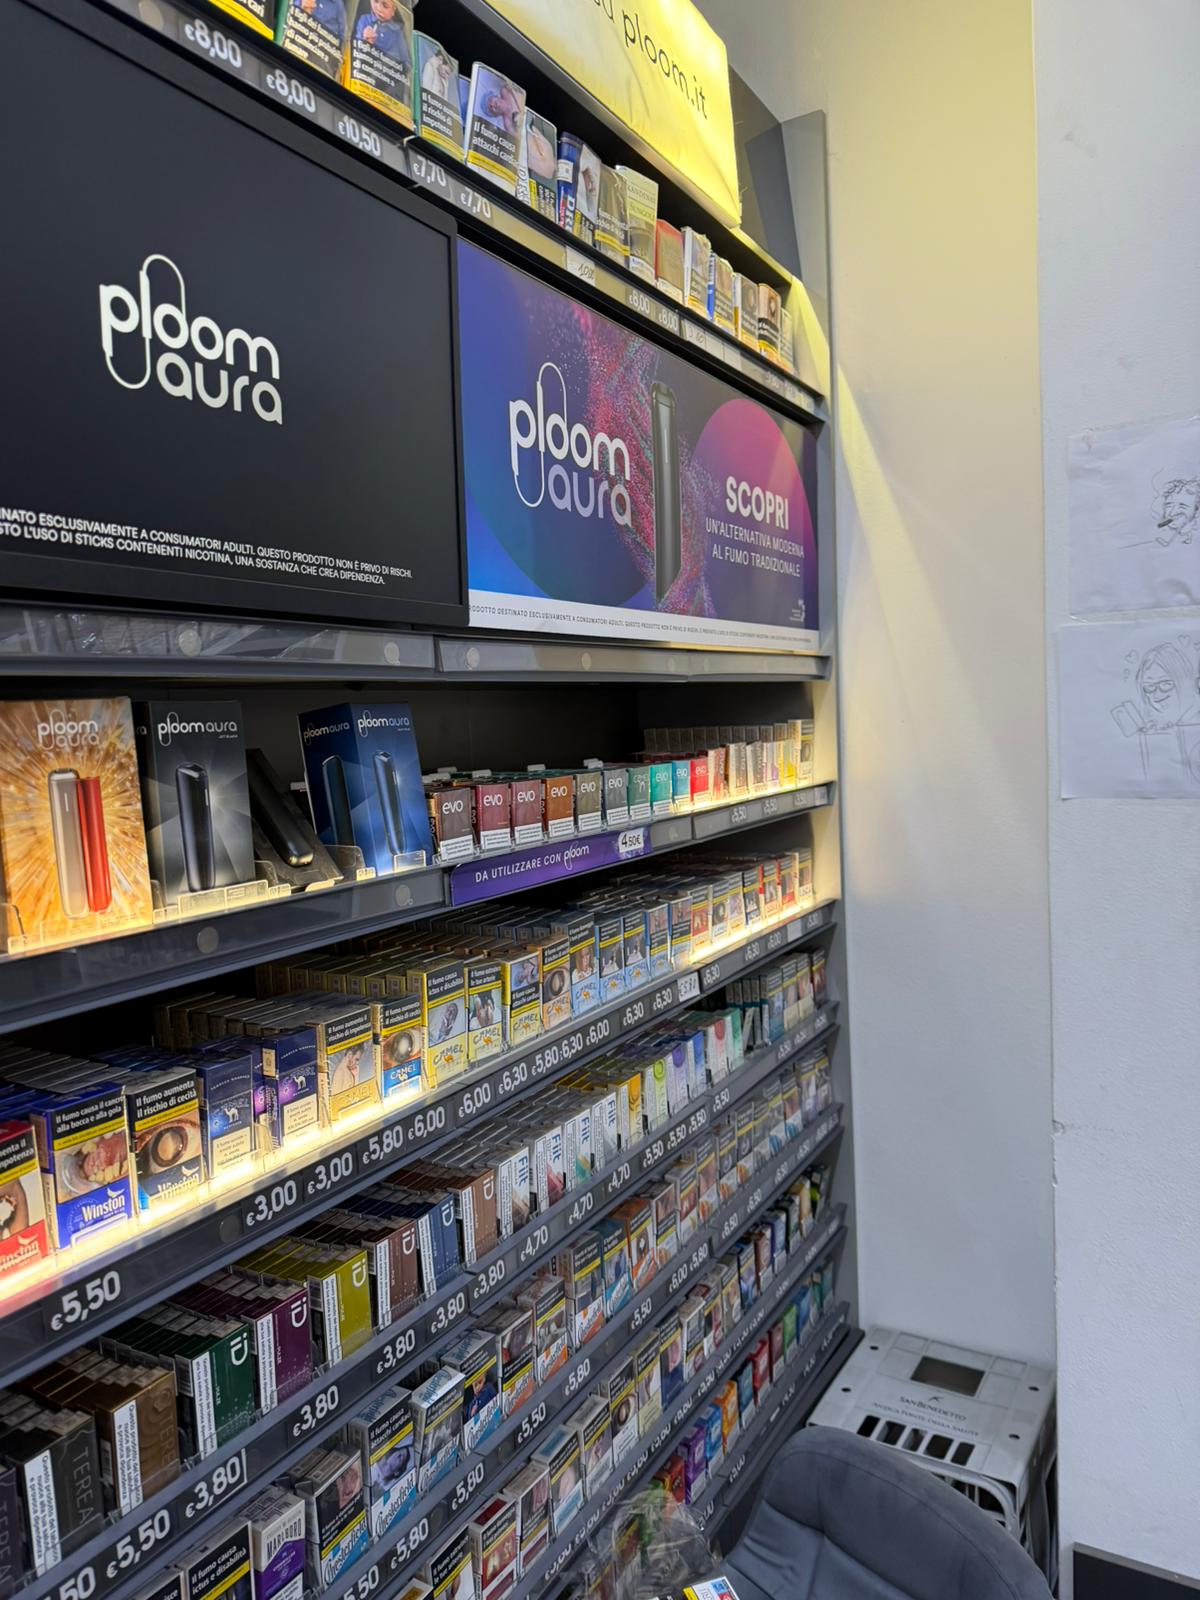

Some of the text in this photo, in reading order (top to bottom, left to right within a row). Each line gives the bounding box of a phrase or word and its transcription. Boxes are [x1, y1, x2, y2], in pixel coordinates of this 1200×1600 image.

[184, 19, 243, 69] €8,00
[622, 10, 707, 120] ploom.it
[266, 69, 316, 113] €8,00
[338, 115, 382, 157] €10,50
[413, 154, 447, 187] €7,70
[460, 186, 491, 218] €7,70
[99, 254, 281, 389] ploom
[157, 352, 283, 425] aura
[509, 362, 631, 507] ploom
[548, 464, 632, 527] aura
[725, 476, 790, 530] SCOPRI
[39, 513, 138, 539] ESCLUSIVAMENTE
[140, 528, 149, 540] A
[150, 530, 221, 551] CONSUMATORI
[223, 541, 255, 555] ADULTI.
[257, 546, 291, 561] QUESTO
[292, 552, 335, 567] PRODOTTO
[336, 559, 353, 570] NON
[354, 560, 359, 571] È
[360, 562, 381, 574] PRIVO
[382, 566, 390, 575] DI
[390, 567, 412, 579] RISCHI.
[706, 517, 805, 559] UN'ALTERNATIVA MODERNA
[24, 526, 58, 543] L'USO
[61, 531, 73, 544] DI
[75, 533, 114, 549] STICKS
[116, 539, 183, 558] CONTENENTI
[185, 549, 234, 565] NICOTINA,
[235, 556, 254, 567] UNA
[255, 558, 300, 574] SOSTANZA
[301, 565, 317, 576] CHE
[318, 567, 339, 579] CREA
[340, 571, 386, 585] DIPENDENZA.
[712, 544, 801, 577] AL FUMO TRADIZIONALE
[37, 709, 98, 750] ploom
[56, 733, 100, 747] aura
[157, 712, 238, 746] ploom aura
[358, 710, 410, 737] ploom aura
[580, 781, 596, 793] evo
[608, 777, 623, 789] evo
[676, 767, 688, 777] evo
[442, 800, 464, 815] evo
[483, 794, 503, 807] evo
[517, 790, 536, 803] evo
[551, 785, 568, 798] evo
[476, 841, 590, 883] DA UTILIZZARE CON ploom
[623, 1002, 644, 1027] €6,30
[653, 988, 673, 1011] €6,30
[473, 1028, 501, 1045] CAMEL
[513, 1013, 538, 1031] CAMEL
[586, 1019, 610, 1046] €6,00
[390, 1063, 417, 1081] CAMEL
[433, 1044, 464, 1066] CAMEL
[531, 1046, 559, 1076] €5,80
[136, 1080, 195, 1107] Il fumo aumenta
[499, 1062, 528, 1094] €6,30
[62, 1111, 80, 1122] fumo
[80, 1104, 99, 1116] causa
[137, 1089, 197, 1118] il rischio di cecità
[458, 1083, 491, 1118] €6,00
[57, 1123, 70, 1133] alla
[71, 1118, 90, 1128] bocca
[96, 1110, 108, 1120] alla
[108, 1106, 122, 1117] gola
[408, 1106, 445, 1140] €6,00
[362, 1125, 403, 1165] €5,80
[643, 1140, 664, 1168] €5,50
[307, 1152, 353, 1195] €3,00
[608, 1163, 630, 1192] €4,70
[82, 1196, 125, 1222] Winston
[246, 1180, 297, 1227] €3,00
[568, 1192, 593, 1225] €4,70
[520, 1226, 549, 1262] €4,70
[473, 1259, 505, 1299] €3,80
[669, 1263, 688, 1293] €6,00
[51, 1270, 121, 1332] €5,50
[431, 1292, 465, 1334] €3,80
[631, 1298, 652, 1330] €5,50
[377, 1328, 416, 1374] €3,80
[564, 1358, 591, 1396] €5,80
[293, 1384, 339, 1437] €3,80
[518, 1401, 546, 1444] €5,50
[71, 1447, 95, 1524] TEREA
[185, 1456, 242, 1518] €3,80
[452, 1462, 485, 1510] €5,80
[106, 1508, 171, 1579] €5,50
[267, 1518, 302, 1563] MARLBORO
[391, 1518, 429, 1570] €5,80
[192, 1579, 210, 1595] ictus
[216, 1546, 247, 1577] disabilità
[198, 1561, 217, 1578] fumo
[217, 1545, 237, 1564] causa
